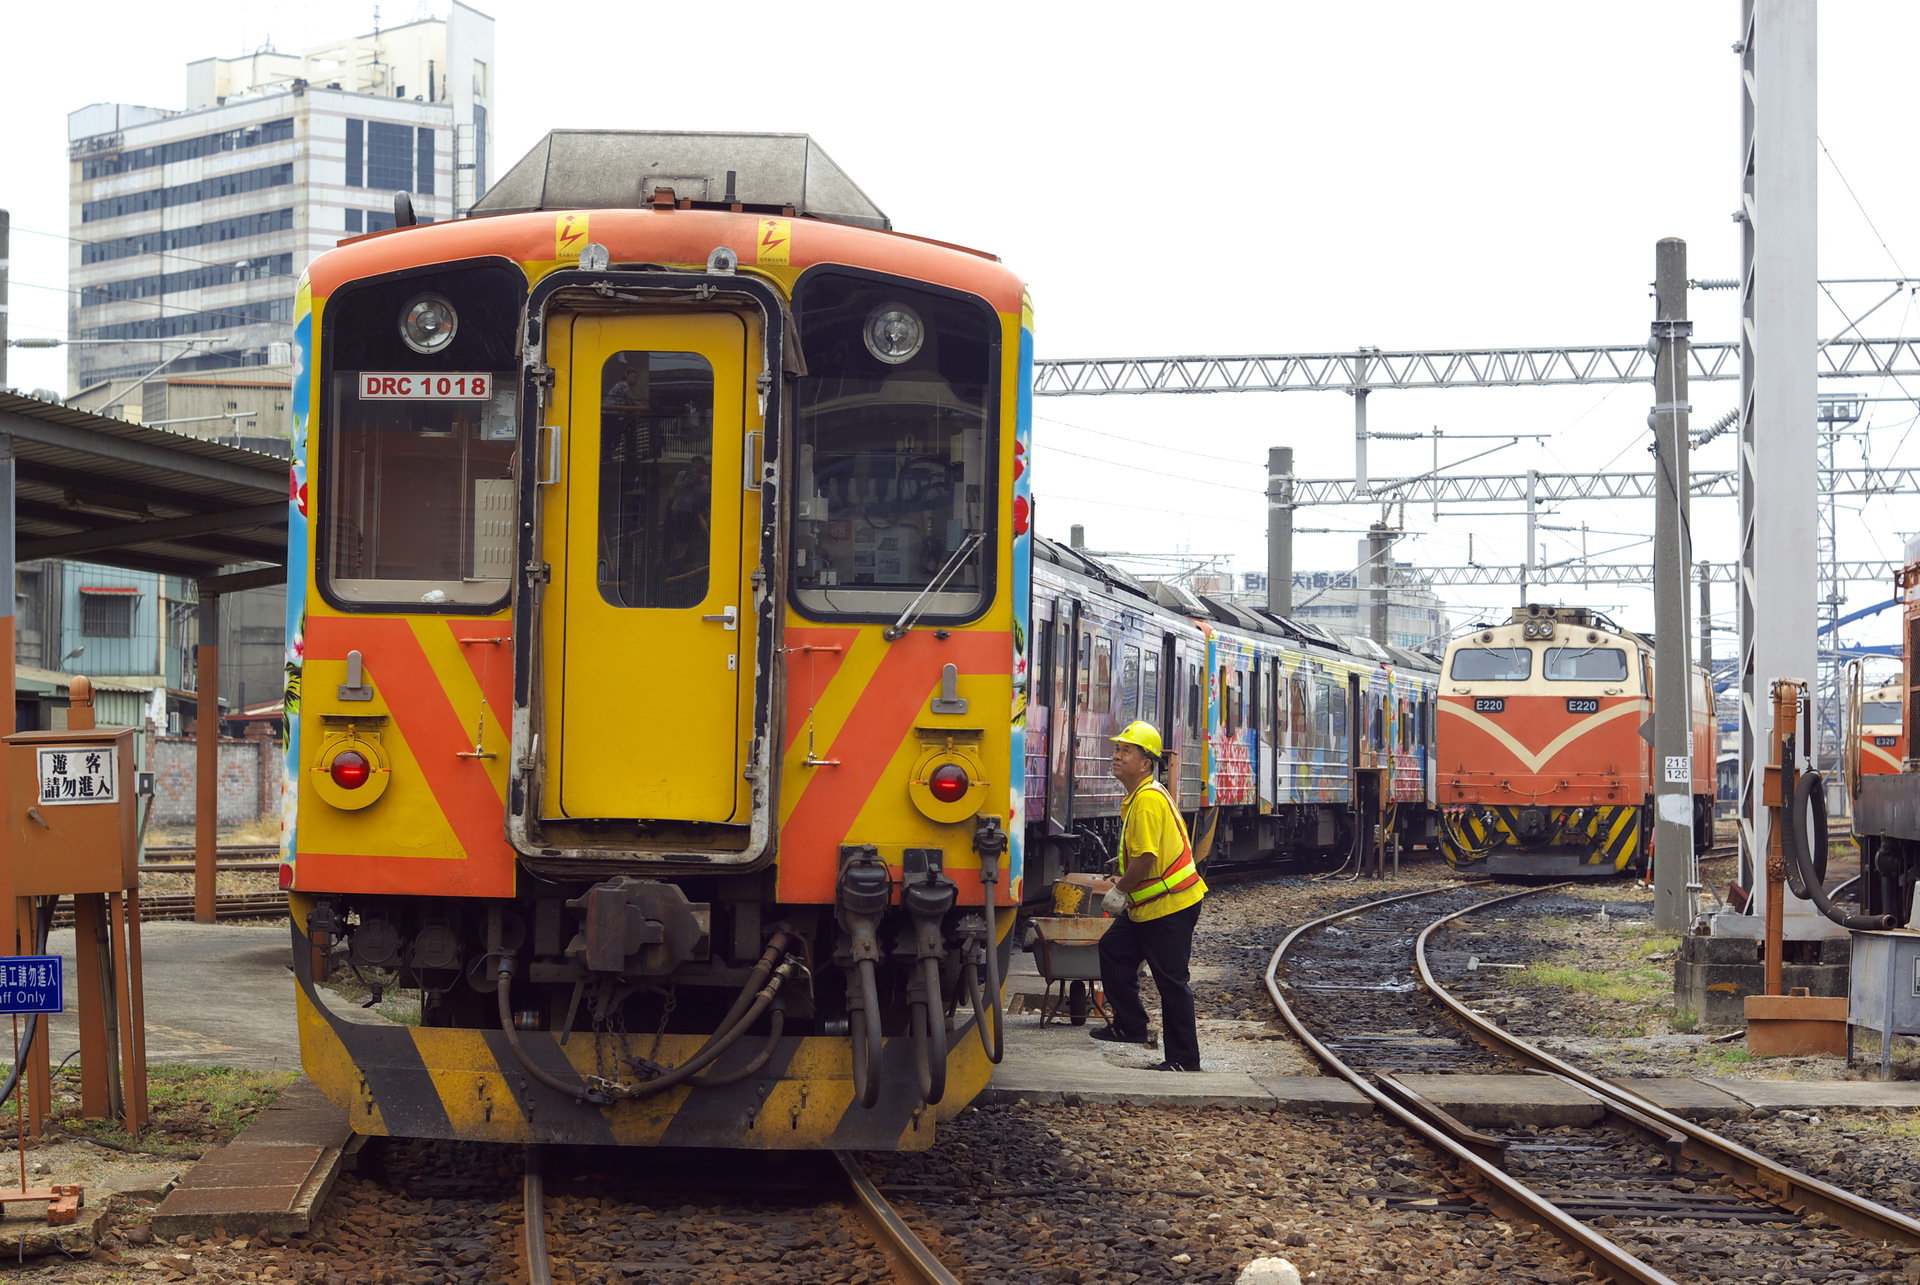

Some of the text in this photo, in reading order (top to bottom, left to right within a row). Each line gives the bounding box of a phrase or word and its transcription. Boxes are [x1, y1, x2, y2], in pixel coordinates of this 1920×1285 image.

[367, 377, 486, 396] DRC 1018
[1476, 700, 1503, 711] E220
[1569, 700, 1597, 711] E220
[1667, 758, 1687, 767] 215
[44, 775, 111, 799] 請勿進入
[16, 991, 46, 1006] Only
